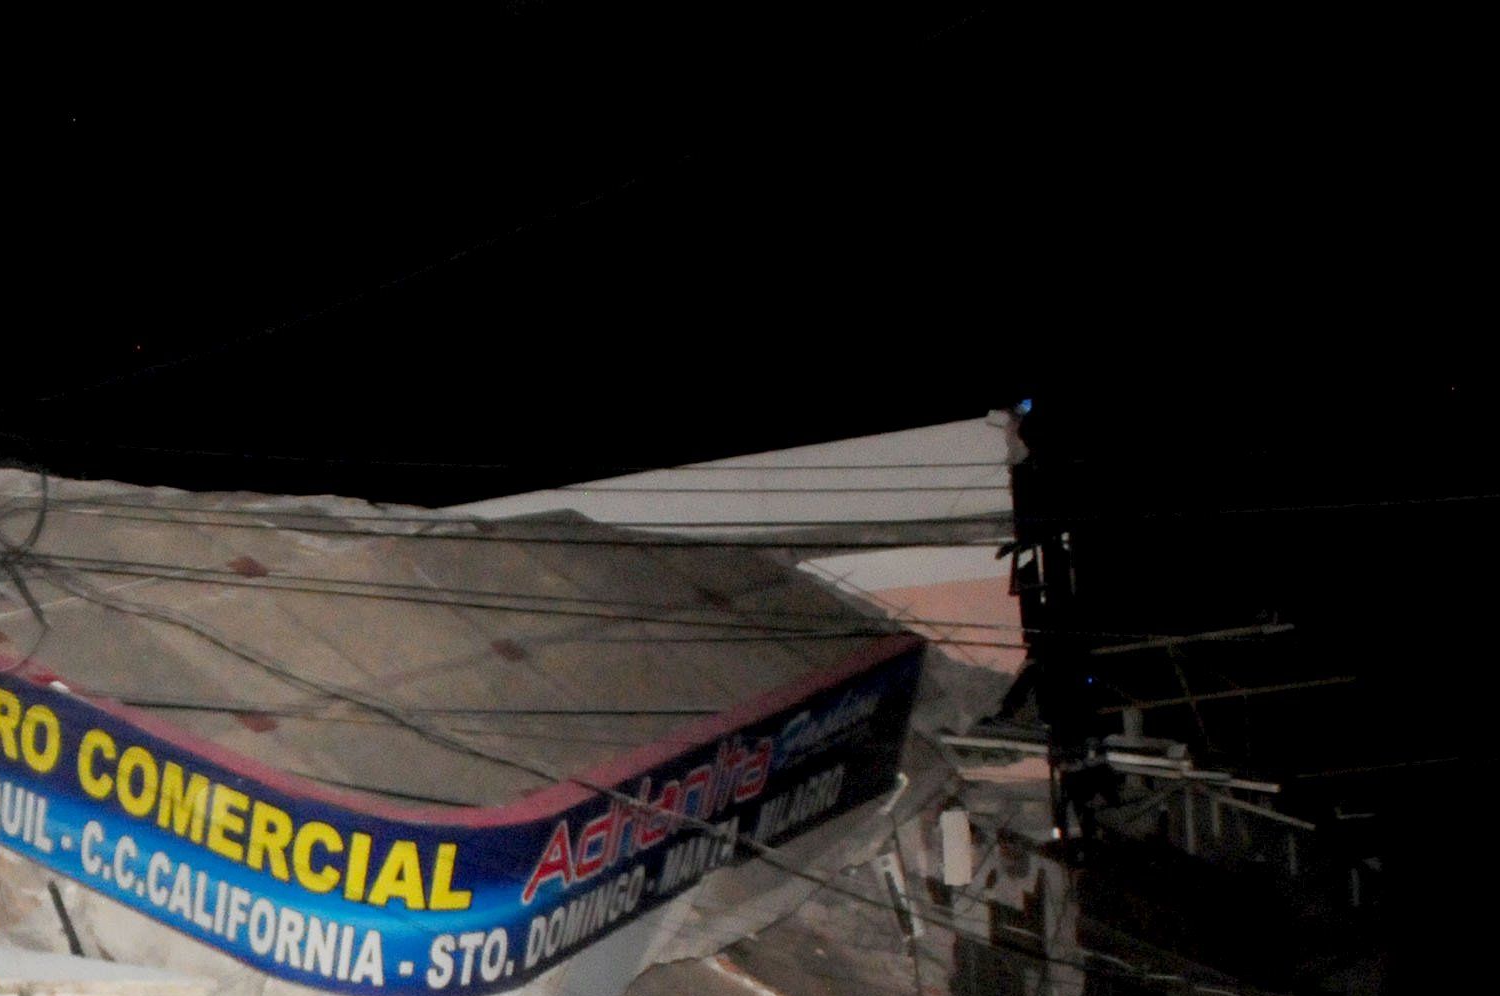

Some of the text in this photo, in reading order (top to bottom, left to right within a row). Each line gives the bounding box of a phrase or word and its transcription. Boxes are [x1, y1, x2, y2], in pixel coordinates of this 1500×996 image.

[77, 727, 473, 911] COMERCIAL
[79, 820, 385, 988] C.C.CALIFORNIA
[426, 928, 516, 990] STO.
[524, 863, 646, 971] DOMINGO
